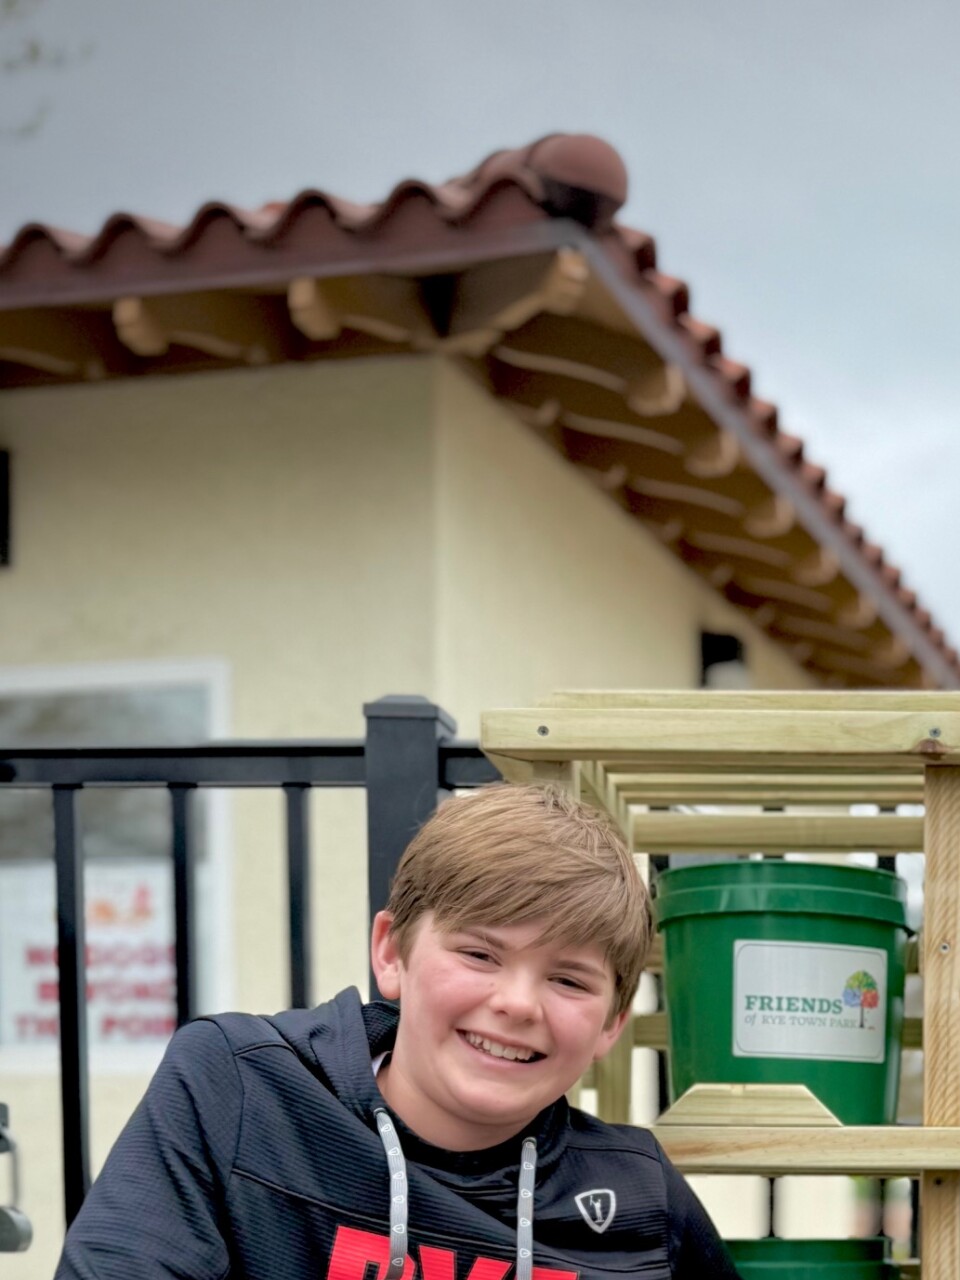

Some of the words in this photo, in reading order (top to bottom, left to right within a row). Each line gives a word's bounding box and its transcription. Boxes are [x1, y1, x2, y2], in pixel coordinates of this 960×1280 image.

[745, 995, 843, 1014] FRIENDS
[744, 1014, 757, 1026] of
[762, 1015, 786, 1025] RYE
[789, 1016, 826, 1027] TOWN
[829, 1018, 857, 1028] PARK
